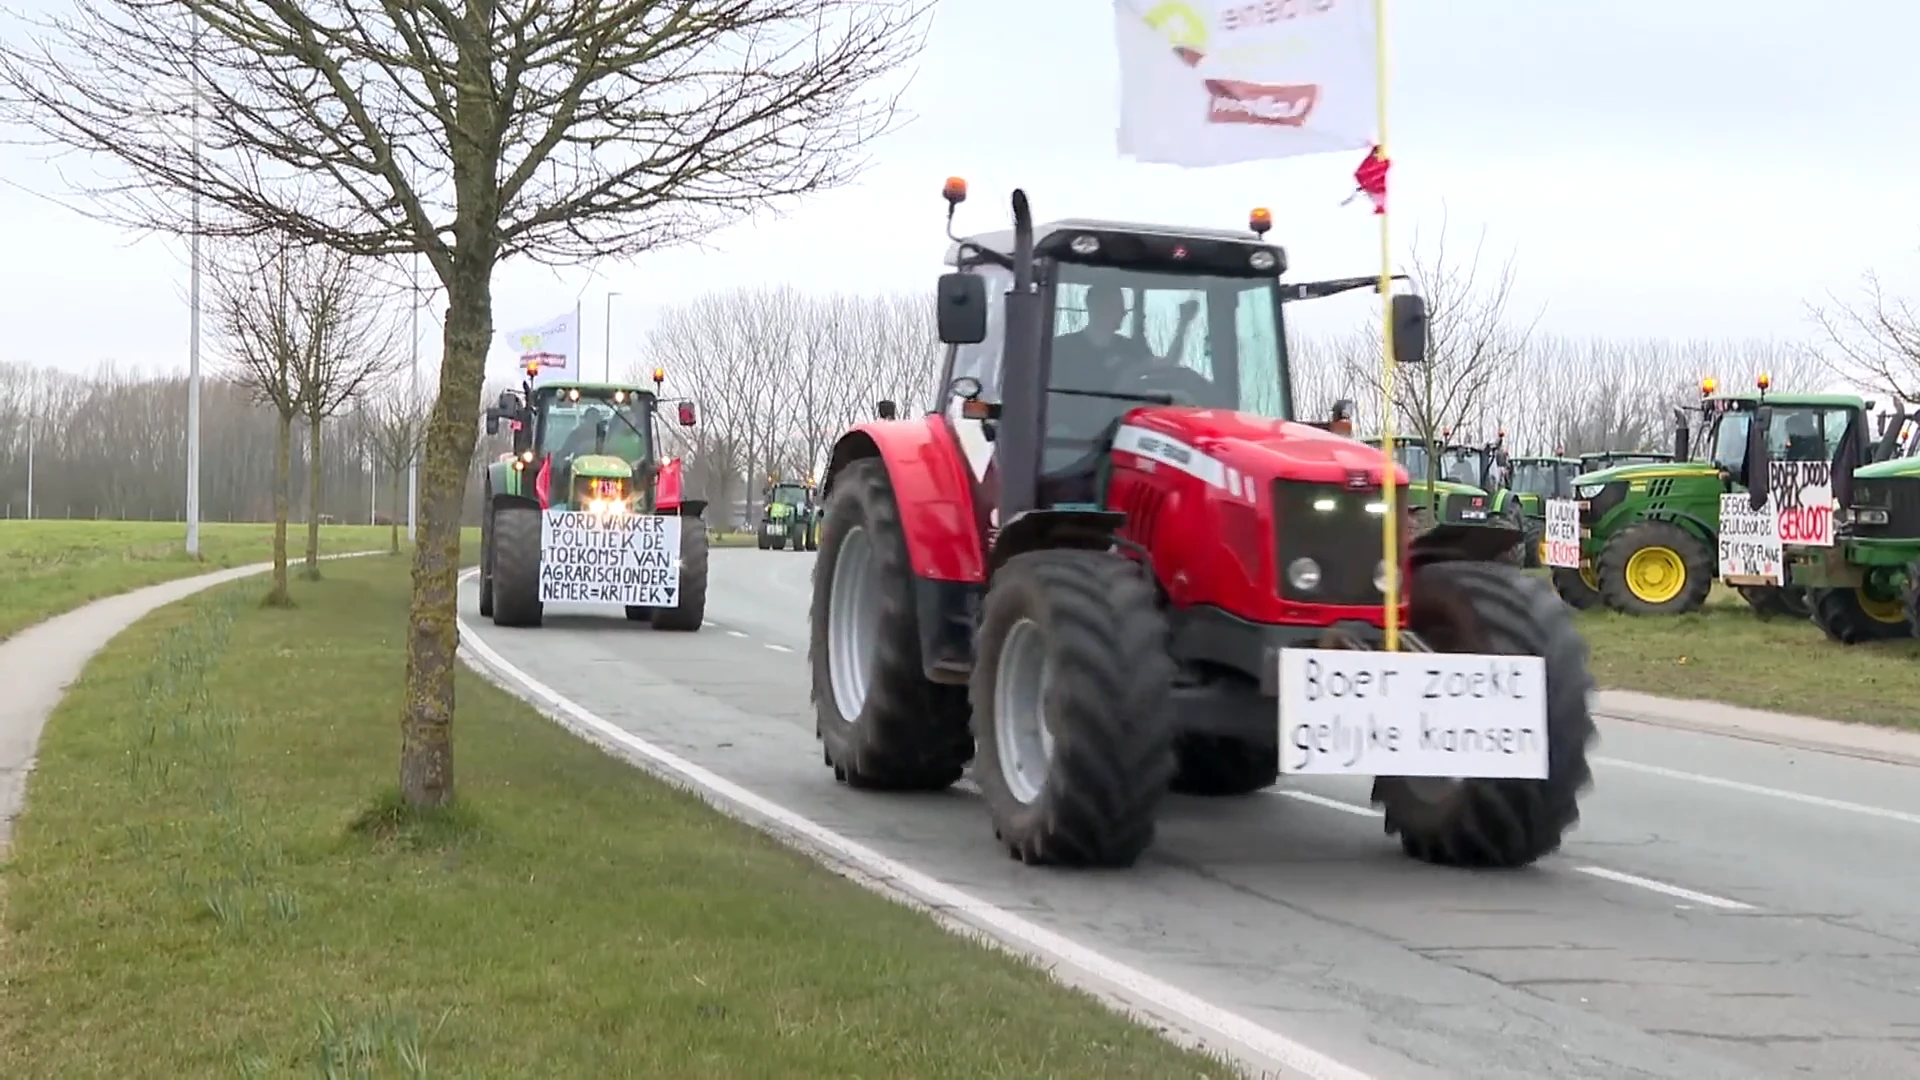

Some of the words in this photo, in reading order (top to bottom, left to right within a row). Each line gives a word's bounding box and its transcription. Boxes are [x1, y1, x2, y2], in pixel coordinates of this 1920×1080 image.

[1770, 462, 1800, 491] BOER
[1802, 462, 1829, 488] DOOD
[547, 511, 595, 530] WORD
[602, 516, 664, 533] WAKKER
[1778, 505, 1832, 543] GEKLOOT
[552, 529, 634, 549] POLITIEK
[643, 533, 664, 550] DE
[548, 546, 628, 566] TOEKOMST
[633, 551, 670, 568] VAN
[1305, 658, 1399, 702] Boer
[1421, 661, 1525, 700] zoekt
[1419, 712, 1539, 755] kansen
